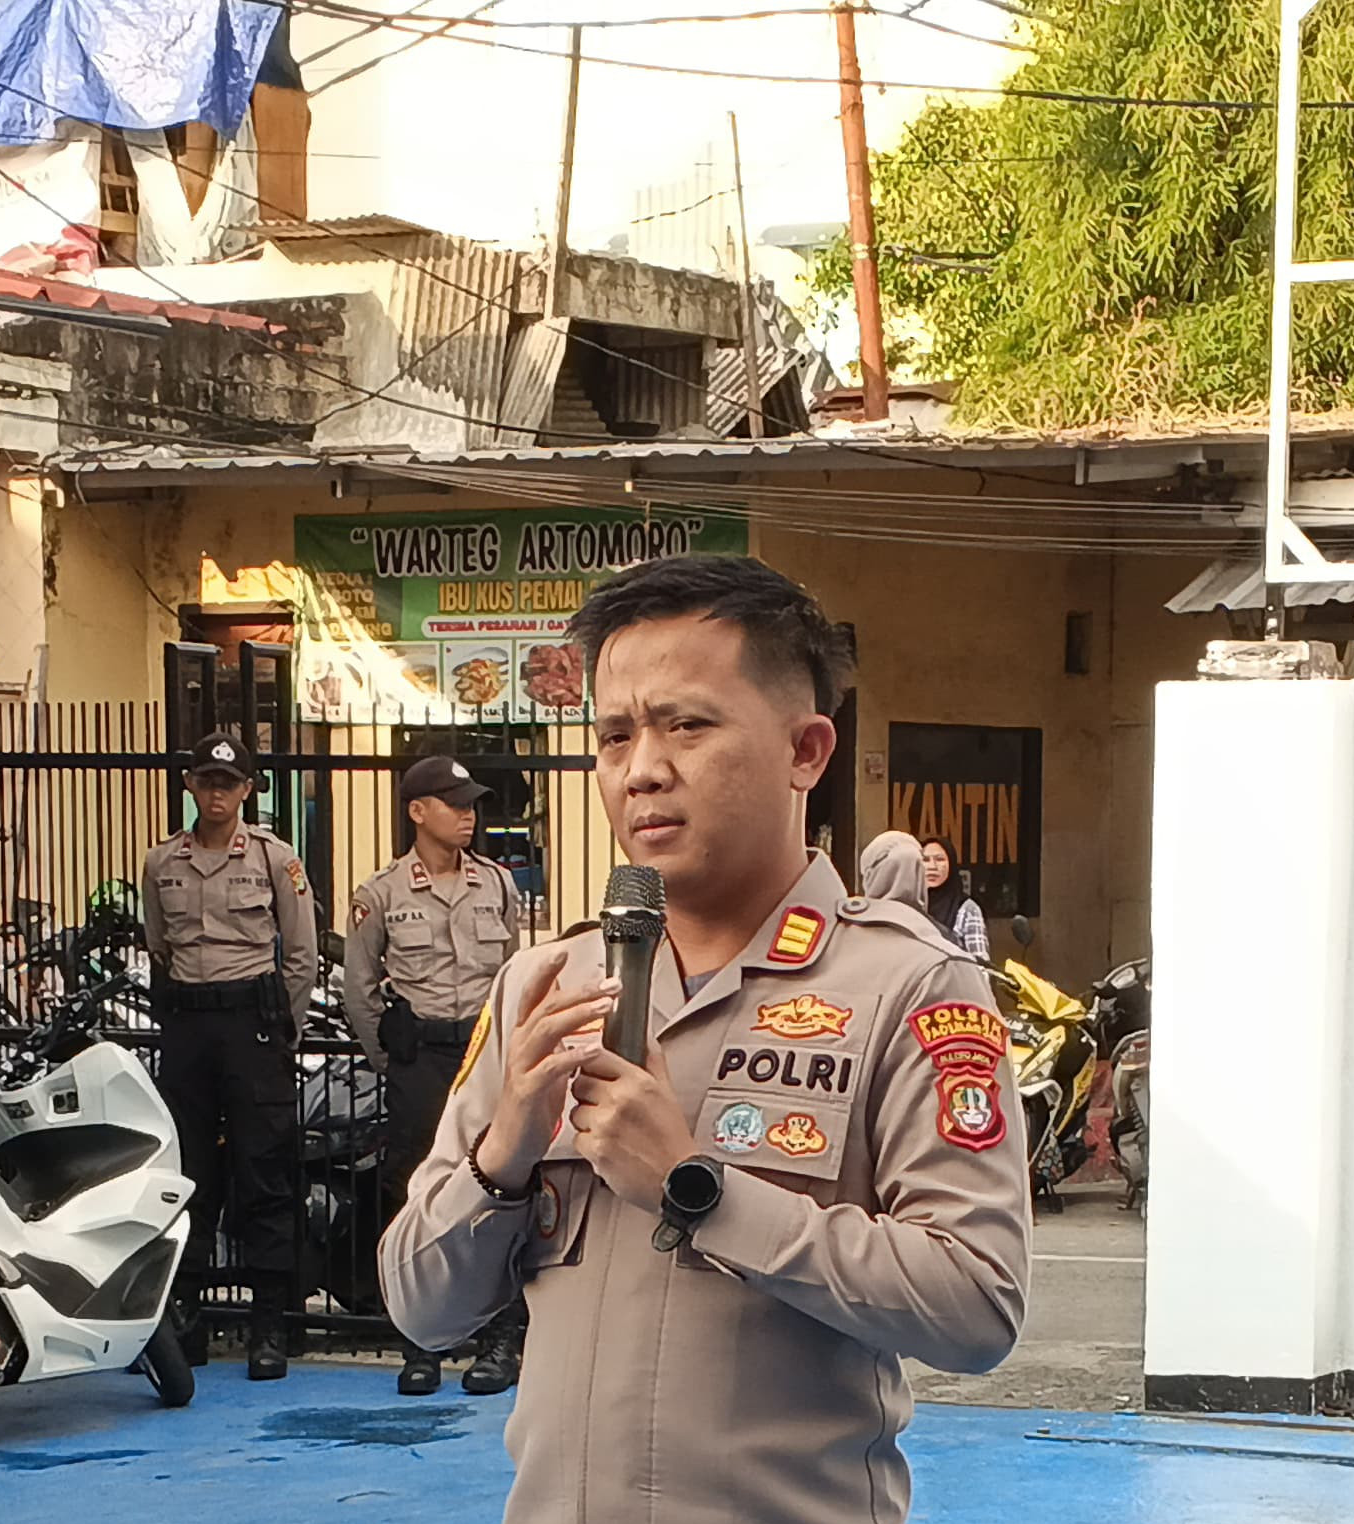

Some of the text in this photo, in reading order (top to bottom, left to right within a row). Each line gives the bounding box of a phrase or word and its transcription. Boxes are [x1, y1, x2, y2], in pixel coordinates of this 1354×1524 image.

[439, 581, 471, 612] IBU
[476, 580, 514, 611] KUS
[892, 782, 1019, 864] KANTIN
[717, 1048, 852, 1094] POLRI
